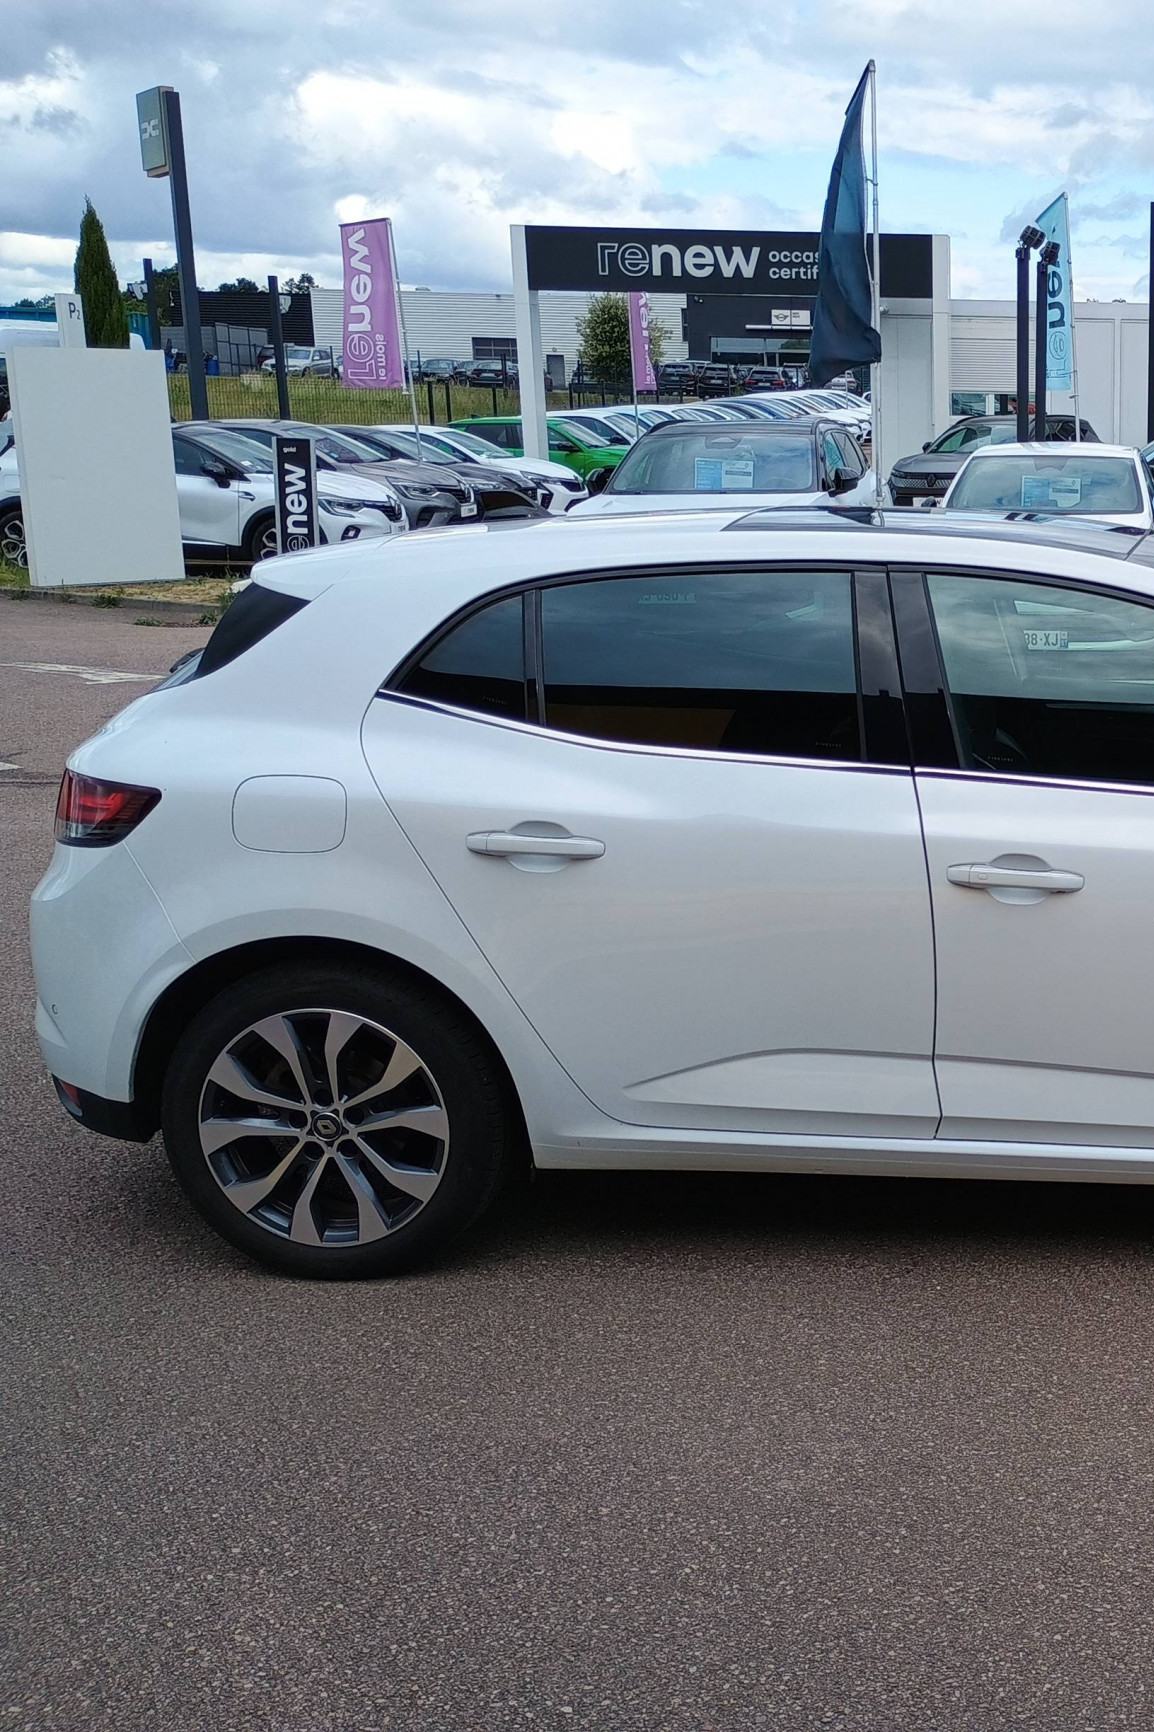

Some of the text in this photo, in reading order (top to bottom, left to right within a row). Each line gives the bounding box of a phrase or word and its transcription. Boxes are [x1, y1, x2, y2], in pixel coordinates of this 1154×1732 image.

[597, 242, 761, 279] renew
[768, 250, 819, 263] occas
[768, 264, 819, 280] certif
[282, 446, 297, 454] gold
[284, 463, 310, 553] enew
